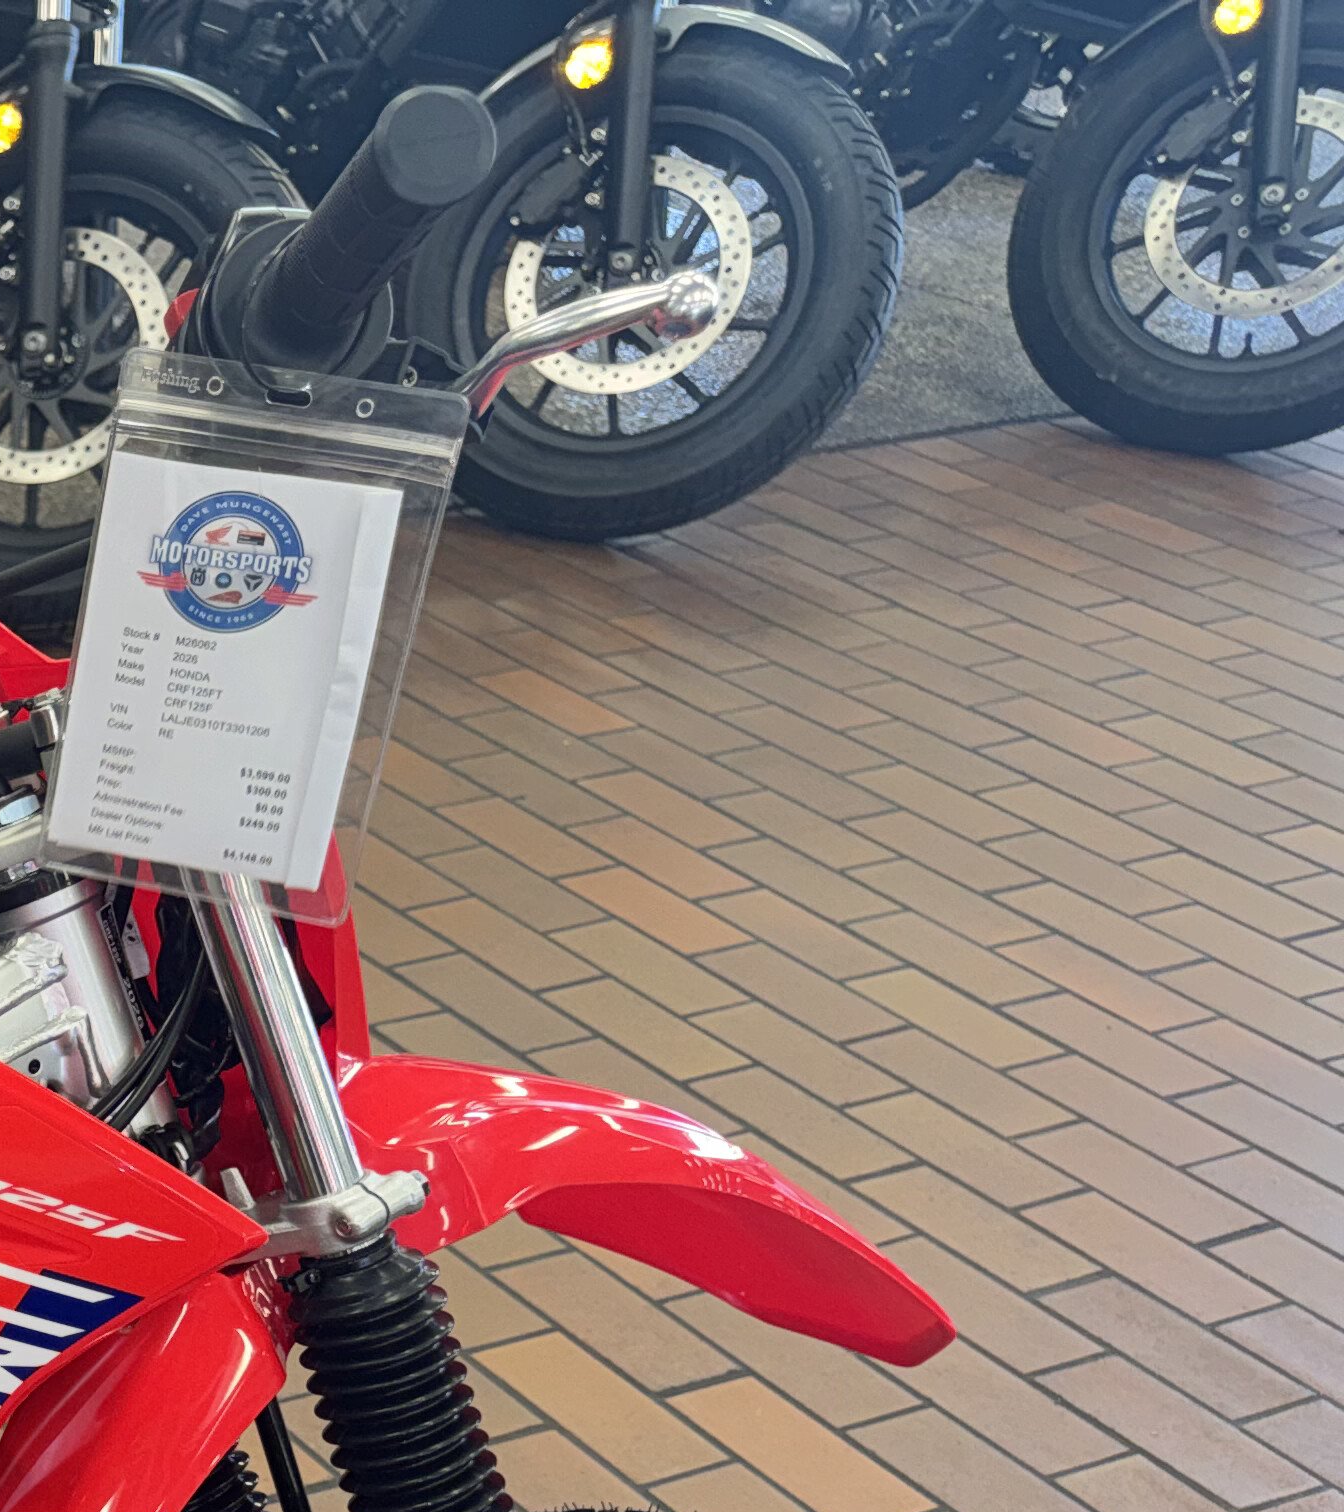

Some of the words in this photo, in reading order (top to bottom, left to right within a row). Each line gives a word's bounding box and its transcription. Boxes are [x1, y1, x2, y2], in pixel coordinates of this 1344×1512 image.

[180, 507, 210, 533] DAVE
[215, 500, 293, 545] MUNGENAST
[150, 534, 312, 584] MOTORSPORTS
[187, 605, 221, 624] SINCE
[123, 627, 151, 640] Stock
[120, 643, 144, 655] Year
[172, 652, 199, 664] 2026
[117, 658, 145, 671] Make
[169, 668, 210, 682] HONDA
[115, 673, 146, 686] Model
[166, 682, 223, 700] CRF125FT
[110, 702, 129, 715] VIN
[164, 697, 213, 713] CRF125F
[107, 718, 133, 731] Color
[158, 728, 174, 740] RE
[255, 802, 284, 816] $0.00
[239, 816, 280, 832] $249.00
